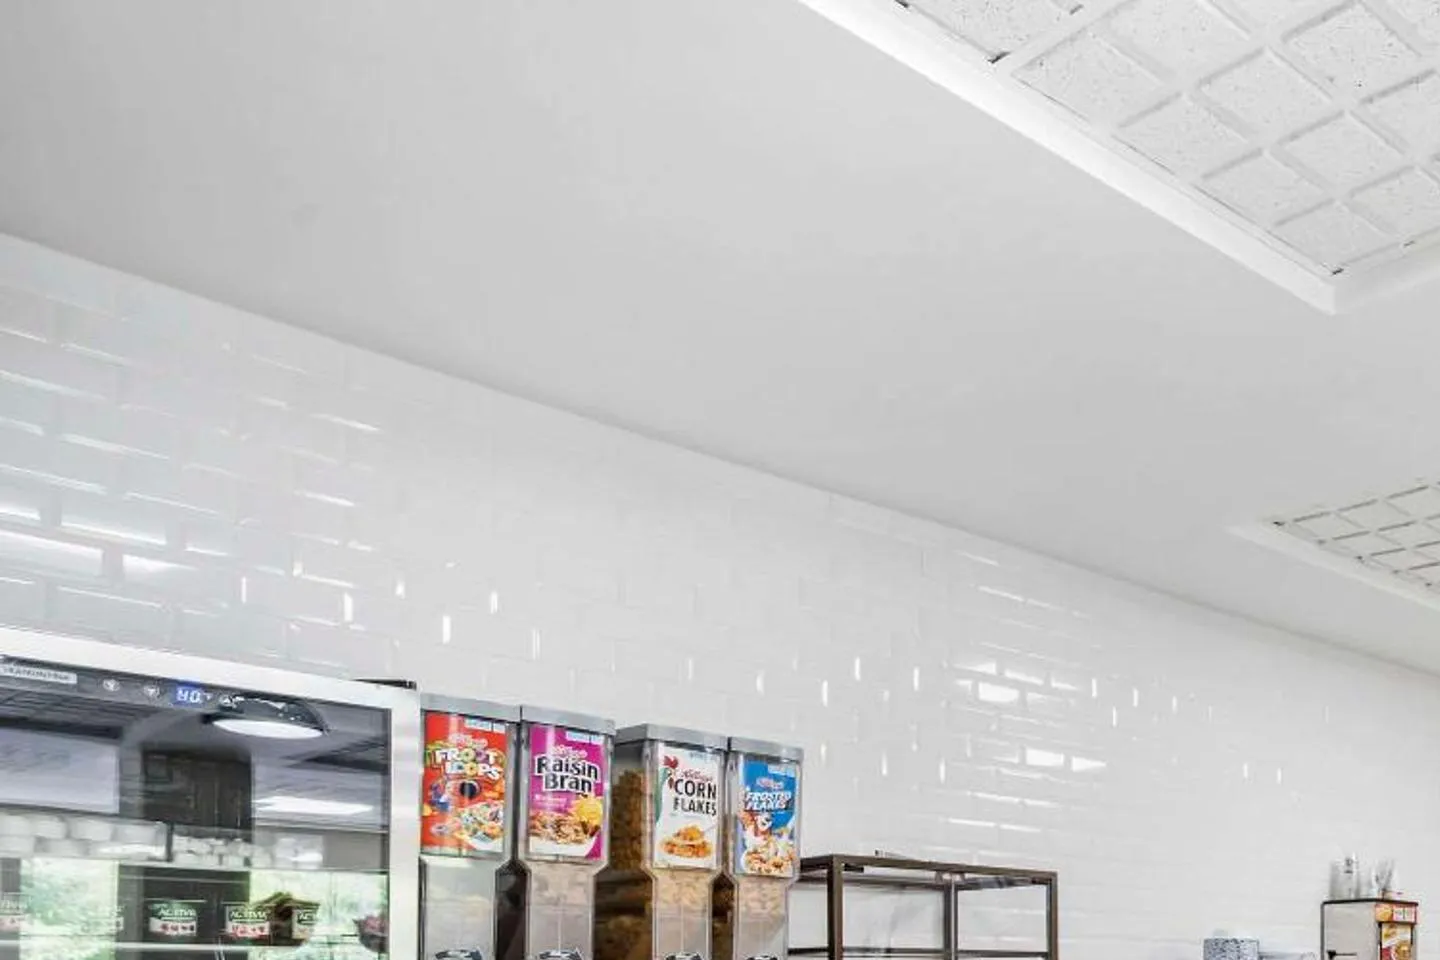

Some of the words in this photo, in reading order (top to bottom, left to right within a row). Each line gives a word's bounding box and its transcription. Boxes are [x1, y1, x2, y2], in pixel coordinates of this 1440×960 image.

[435, 748, 498, 765] FROOT
[536, 756, 598, 781] Raisin
[544, 773, 592, 794] Bran
[674, 778, 717, 799] CORN
[673, 797, 717, 817] FLAKES
